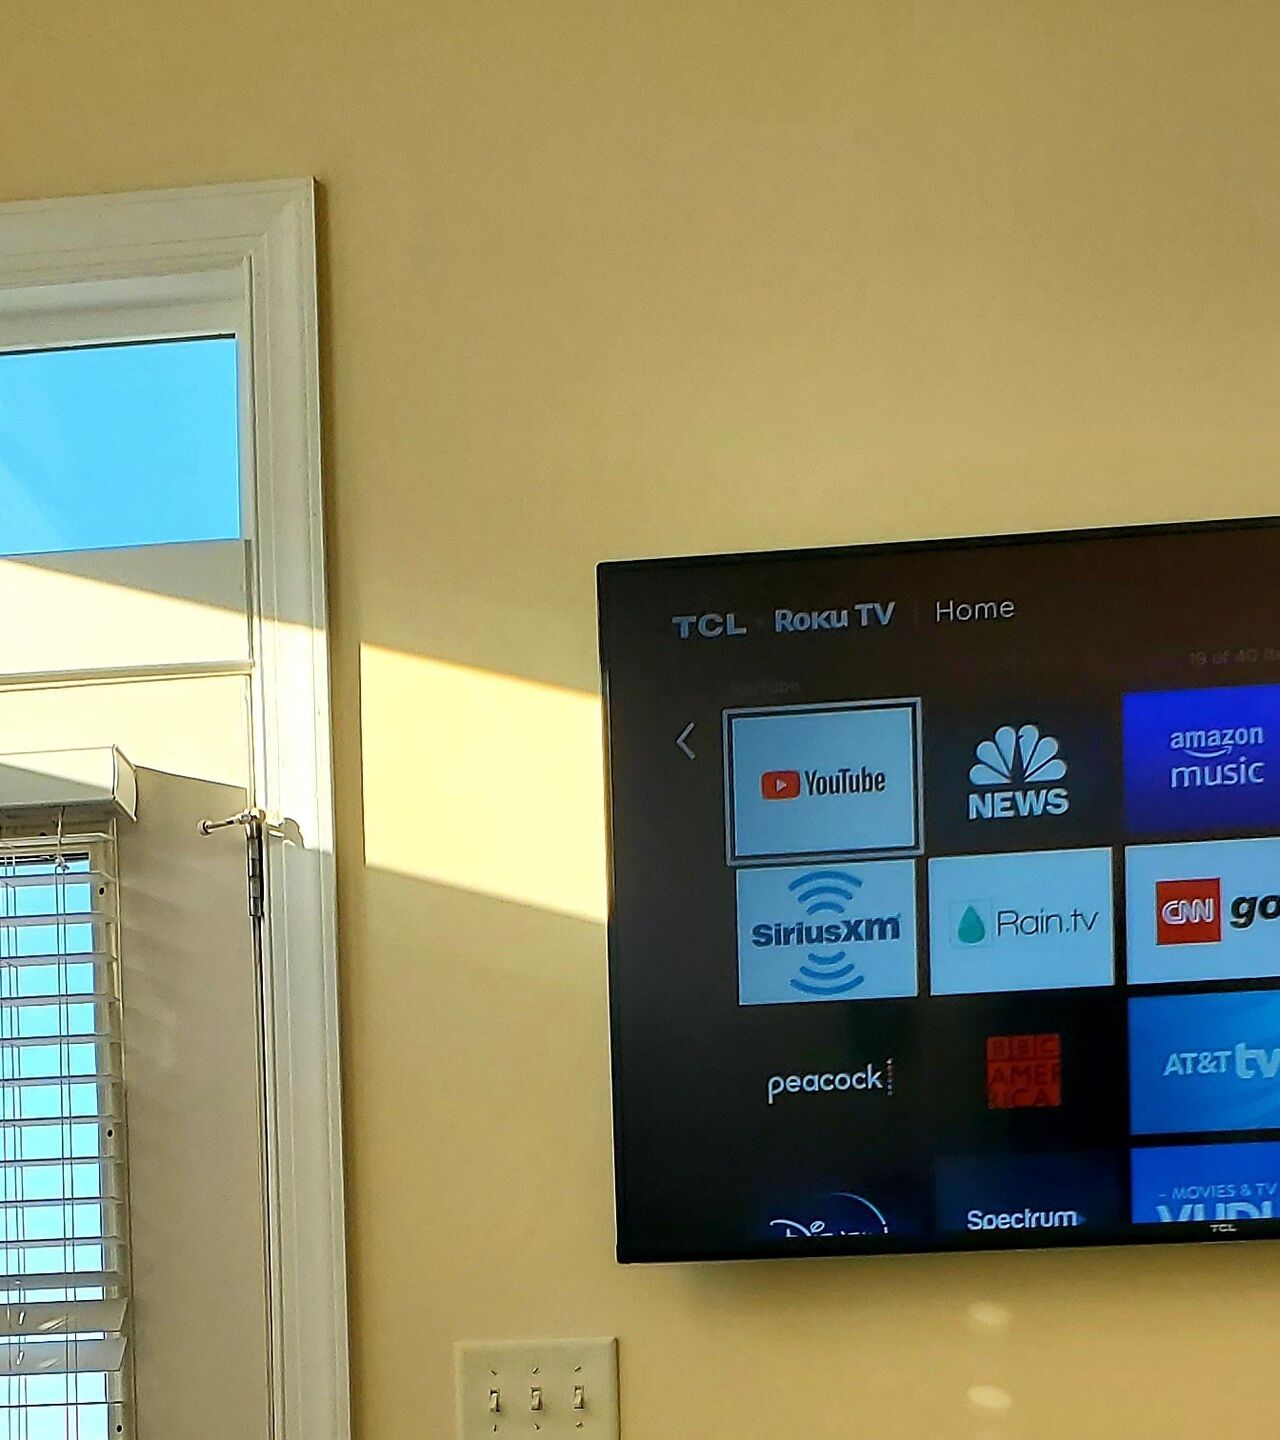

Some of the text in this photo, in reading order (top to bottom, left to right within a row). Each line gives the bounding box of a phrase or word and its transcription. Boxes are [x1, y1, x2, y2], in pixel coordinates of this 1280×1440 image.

[672, 602, 895, 639] TCL Roku TV
[936, 597, 1015, 622] Home
[1212, 649, 1230, 664] of
[1170, 724, 1264, 752] amazon
[805, 767, 886, 797] YouTube
[1170, 755, 1264, 788] music
[968, 788, 1069, 820] NEWS
[996, 906, 1099, 939] Rain.tv
[1161, 897, 1215, 925] CNN
[1162, 1051, 1231, 1076] AT&T
[768, 1064, 883, 1104] peacock
[1172, 1183, 1278, 1200] MOVIES & TV
[1209, 1224, 1238, 1233] TCL
